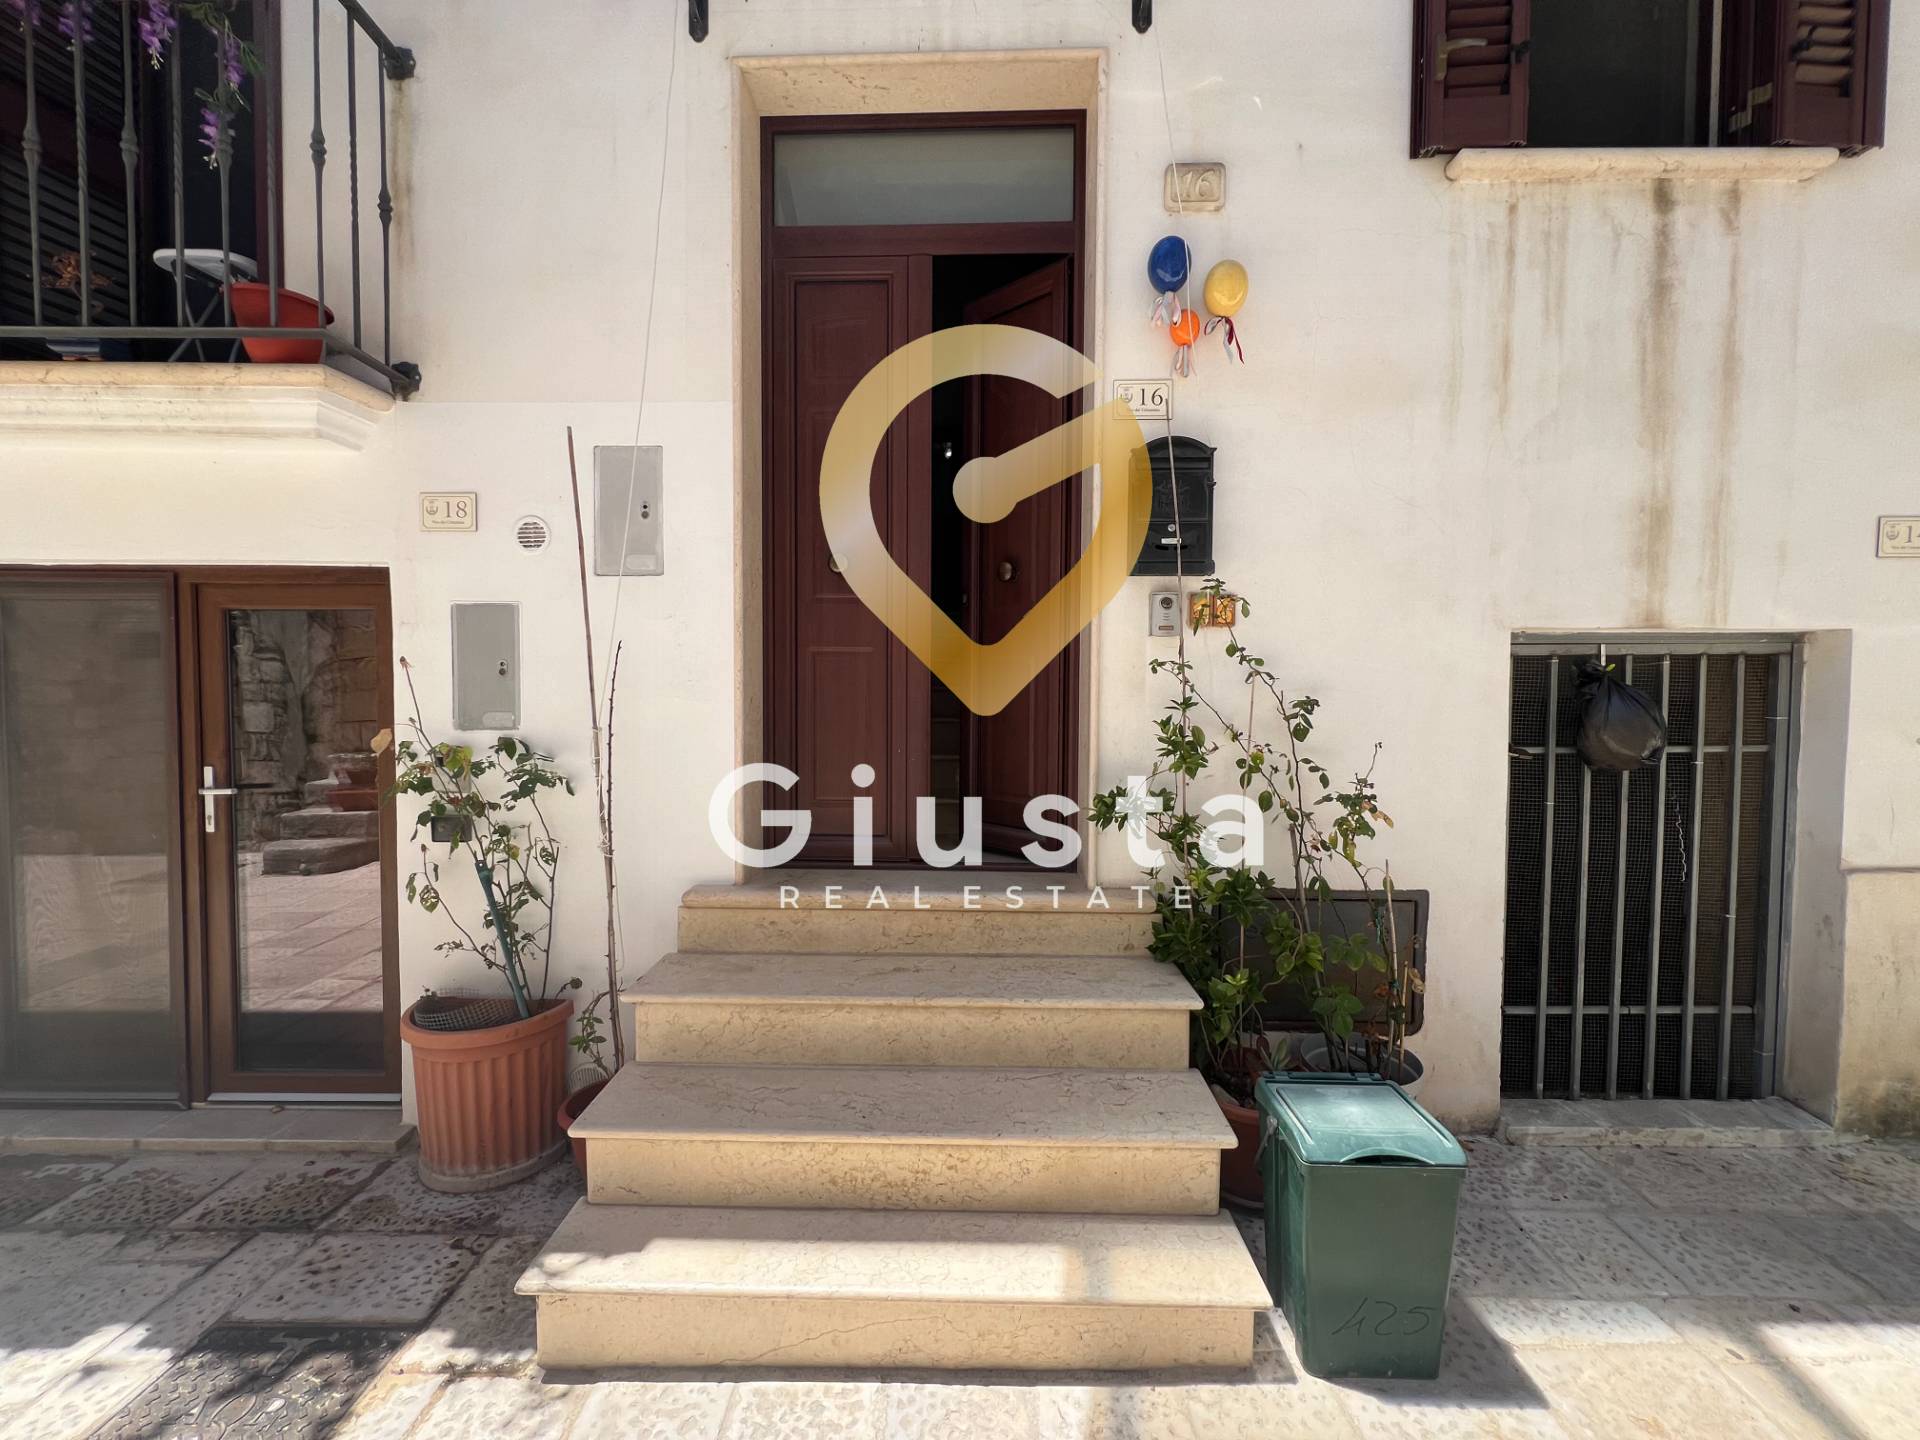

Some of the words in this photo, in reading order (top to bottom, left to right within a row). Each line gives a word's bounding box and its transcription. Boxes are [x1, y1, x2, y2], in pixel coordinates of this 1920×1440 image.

[1140, 387, 1164, 406] 16
[444, 500, 468, 518] 18
[1904, 525, 1920, 543] 1
